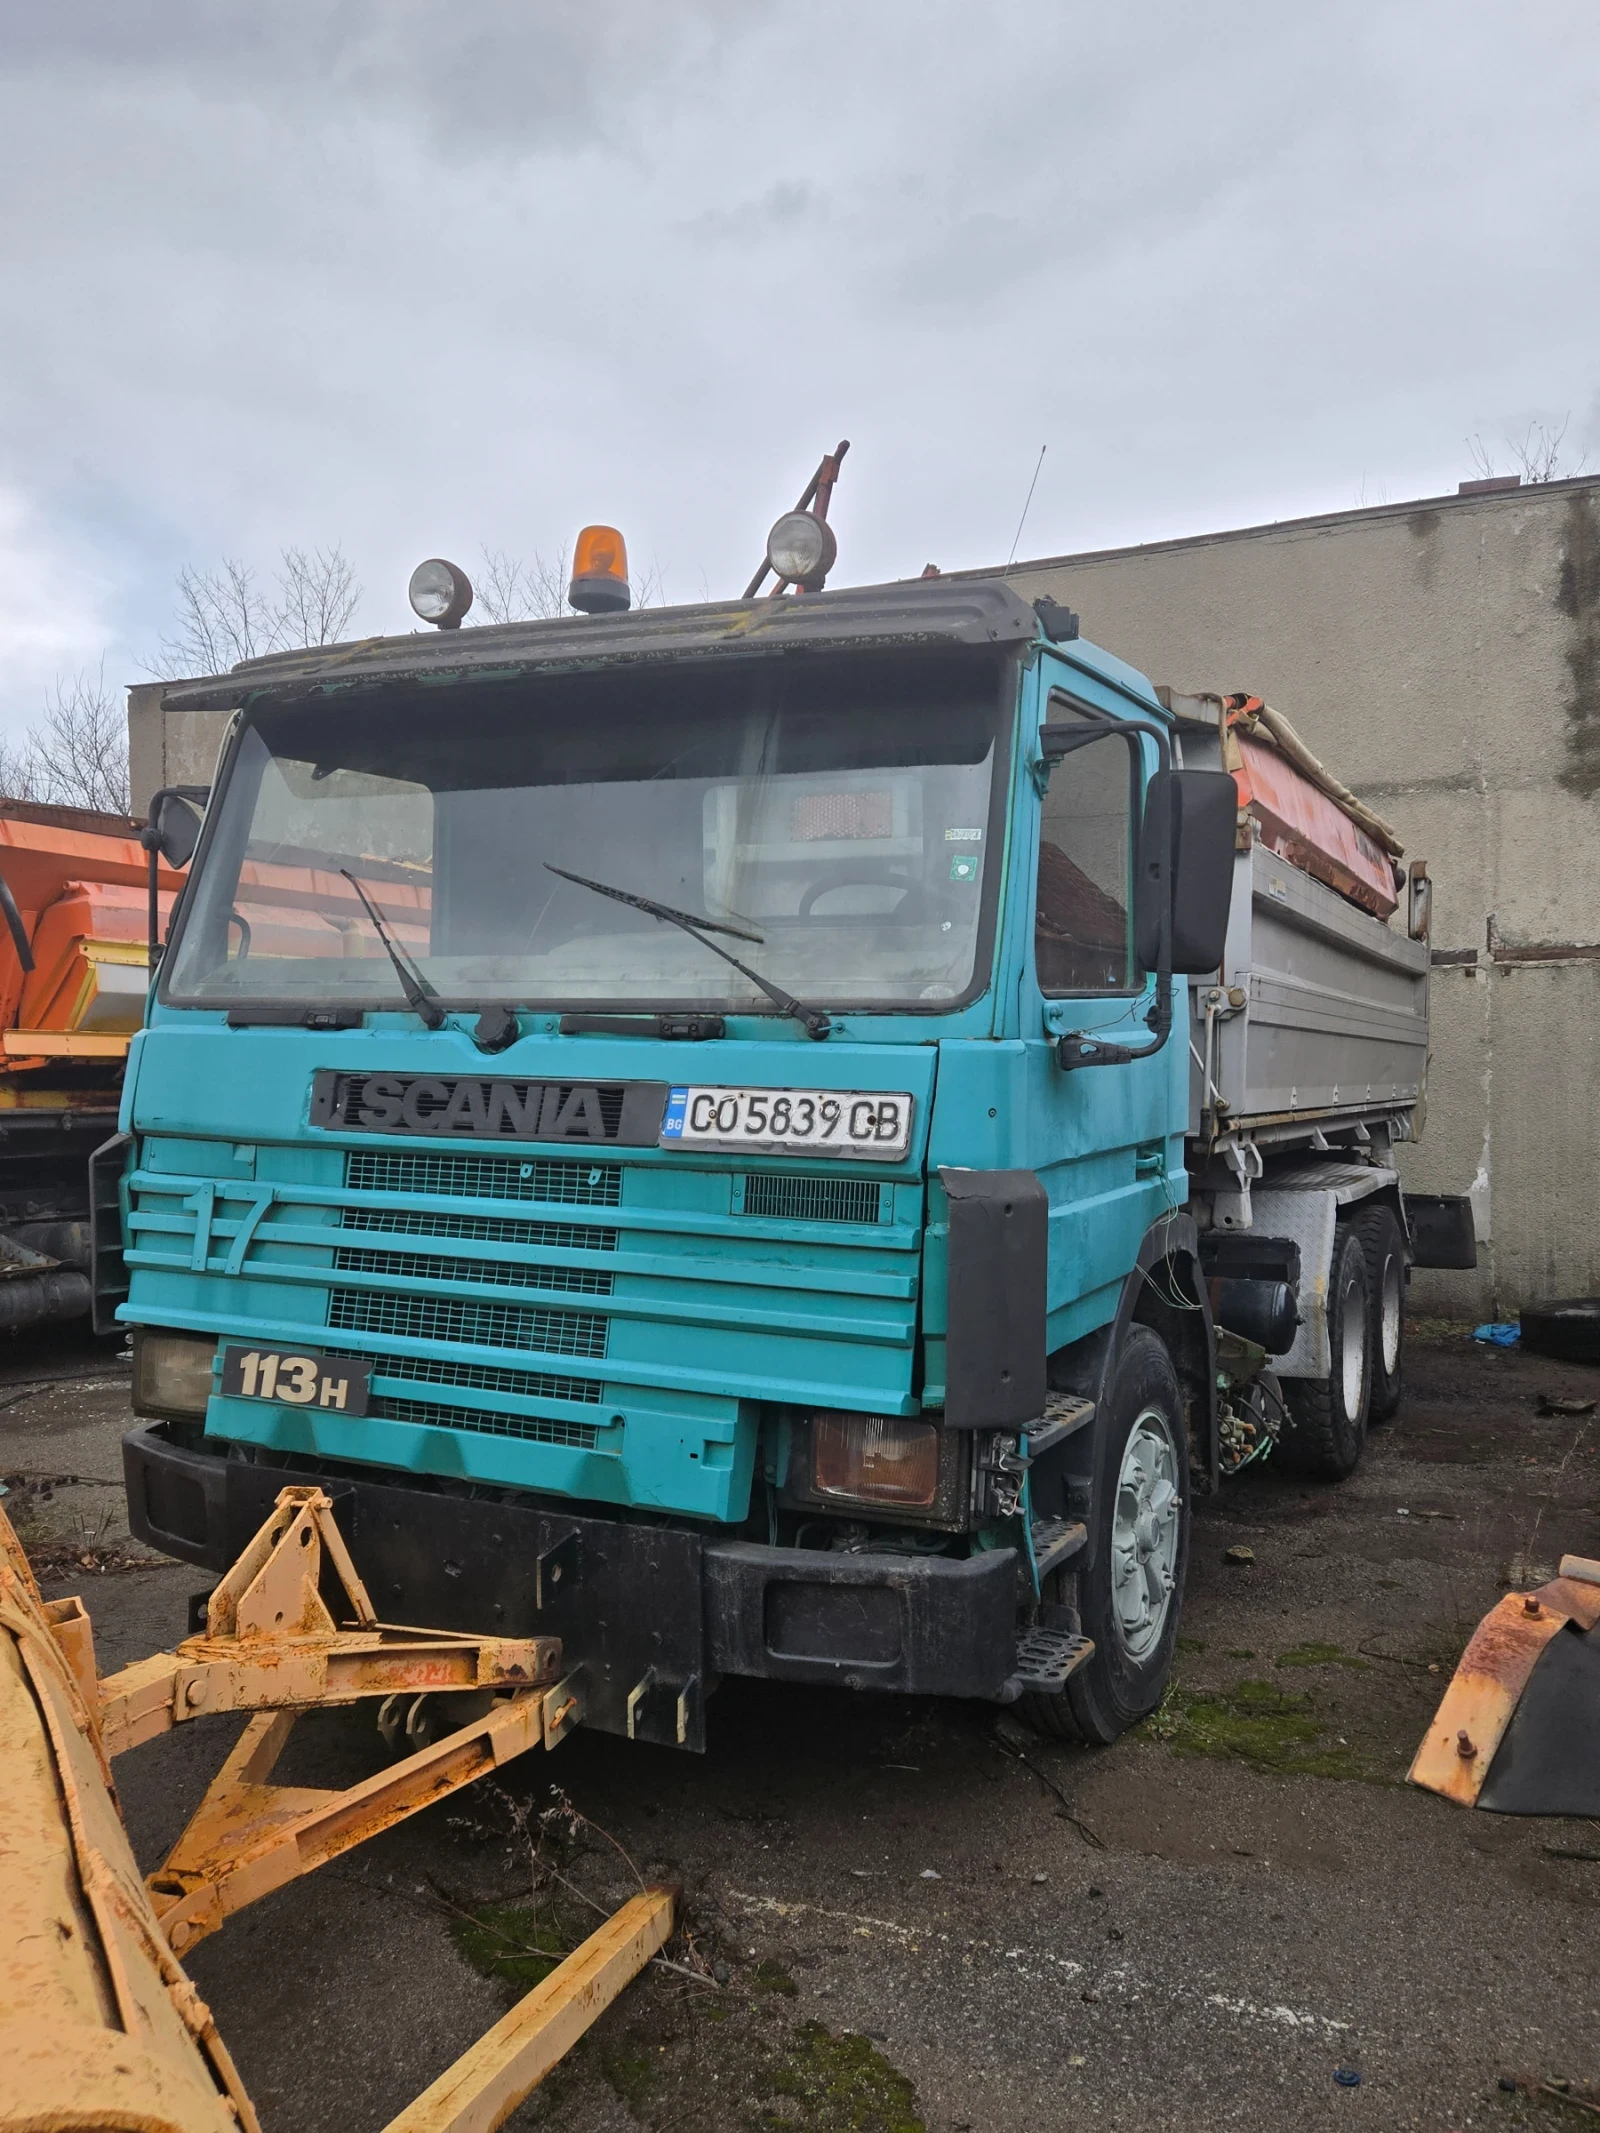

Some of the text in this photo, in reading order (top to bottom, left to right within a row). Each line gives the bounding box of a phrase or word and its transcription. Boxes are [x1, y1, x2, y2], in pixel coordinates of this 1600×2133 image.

[358, 1078, 606, 1138] SCANIA
[666, 1118, 683, 1131] BG
[183, 1181, 275, 1275] 17
